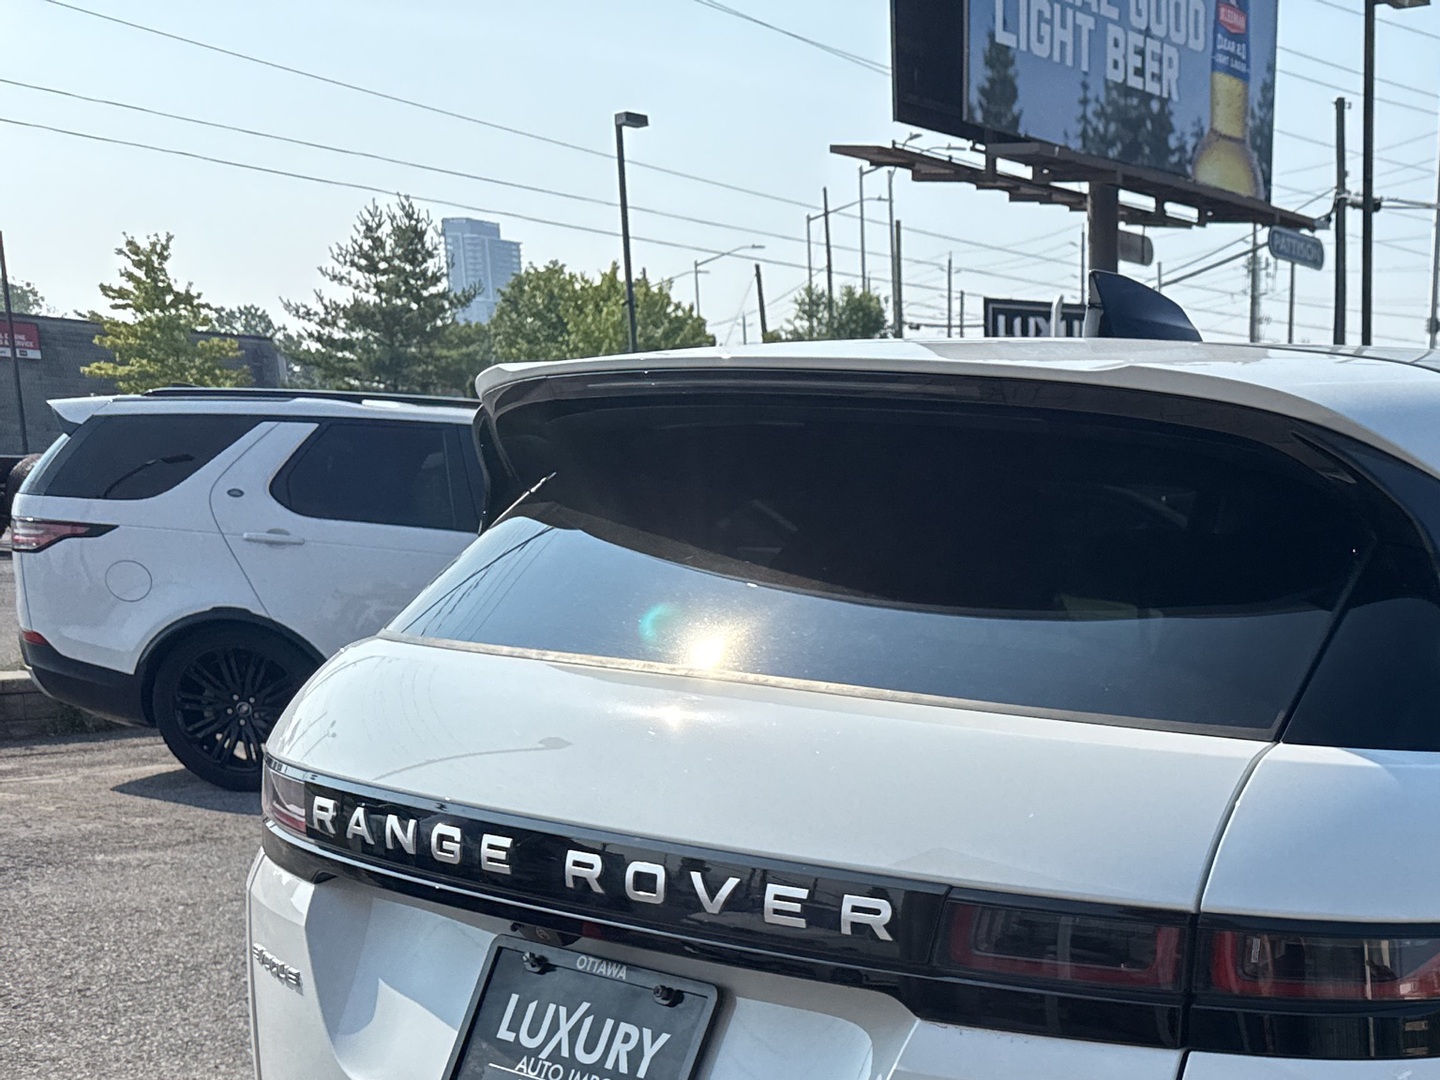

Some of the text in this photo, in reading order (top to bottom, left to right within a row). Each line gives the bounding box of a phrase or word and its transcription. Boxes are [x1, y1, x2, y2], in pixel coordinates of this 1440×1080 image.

[995, 0, 1180, 102] LIGHT BEER
[312, 795, 894, 942] RANGE ROVER
[575, 955, 628, 980] OTTAWA
[496, 993, 671, 1079] LUXURY
